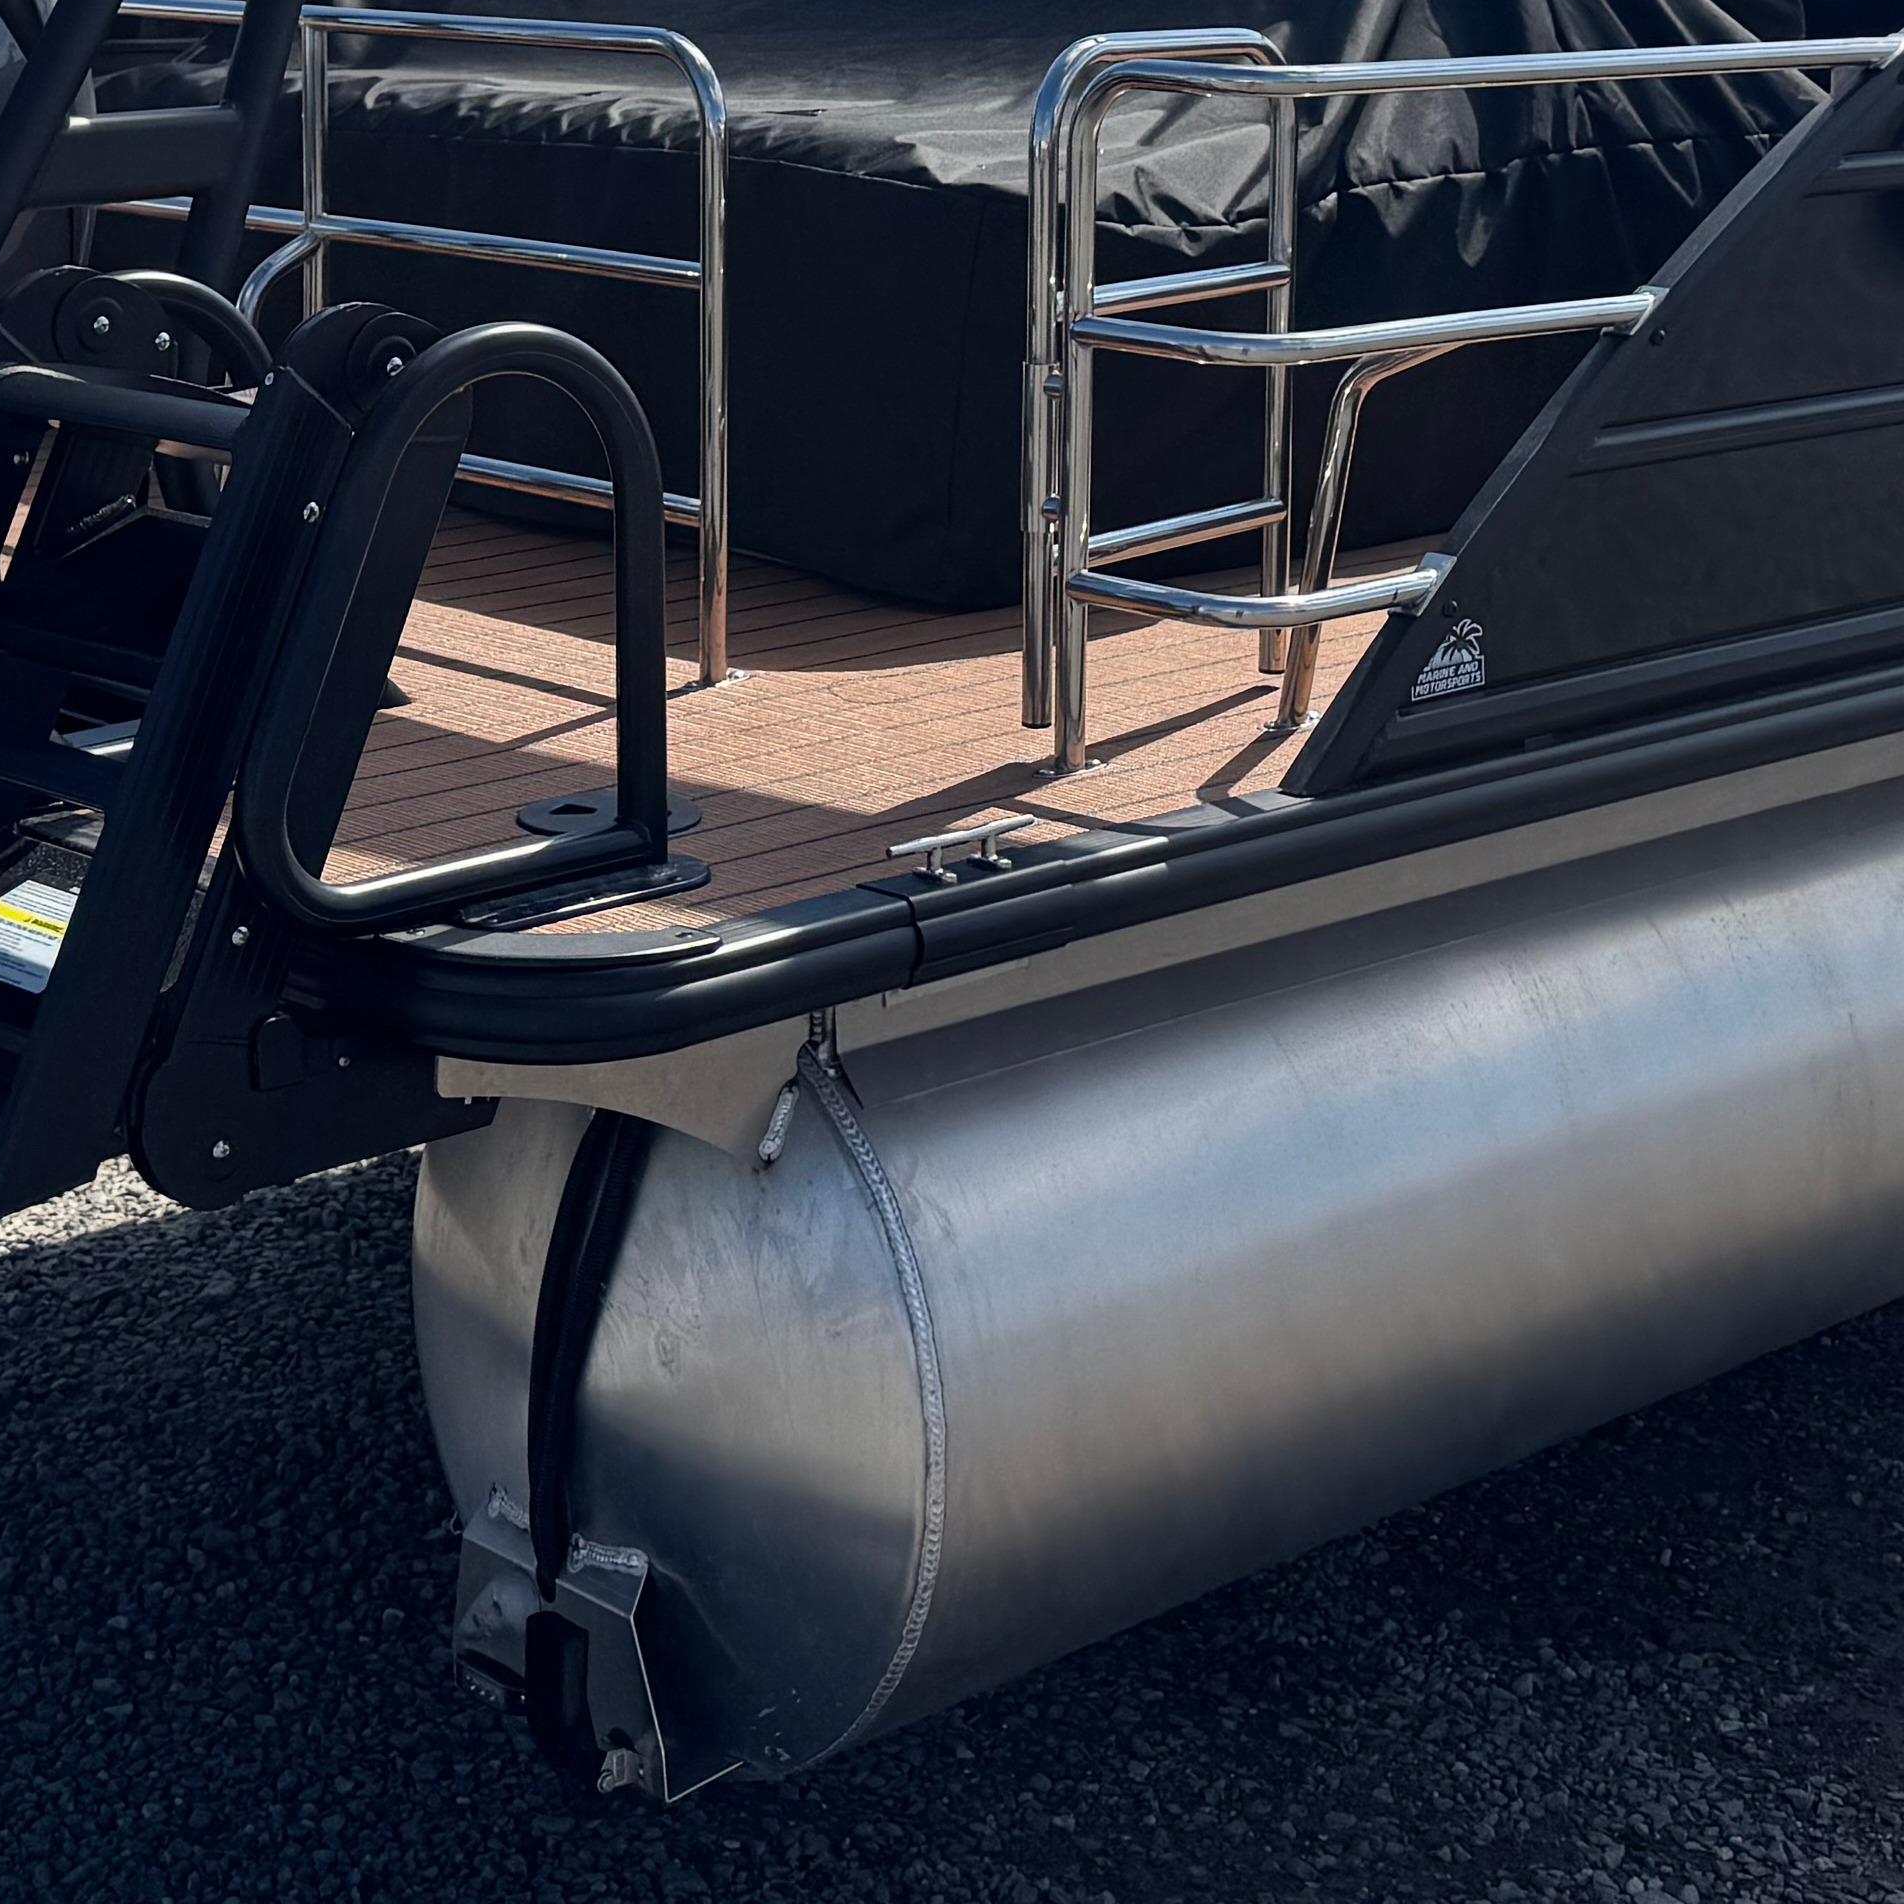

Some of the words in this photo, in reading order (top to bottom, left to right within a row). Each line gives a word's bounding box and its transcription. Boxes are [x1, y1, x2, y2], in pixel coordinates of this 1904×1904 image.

[1415, 671, 1481, 696] MOTORSPORTS
[1417, 666, 1456, 684] MARINE
[1458, 661, 1479, 675] AND
